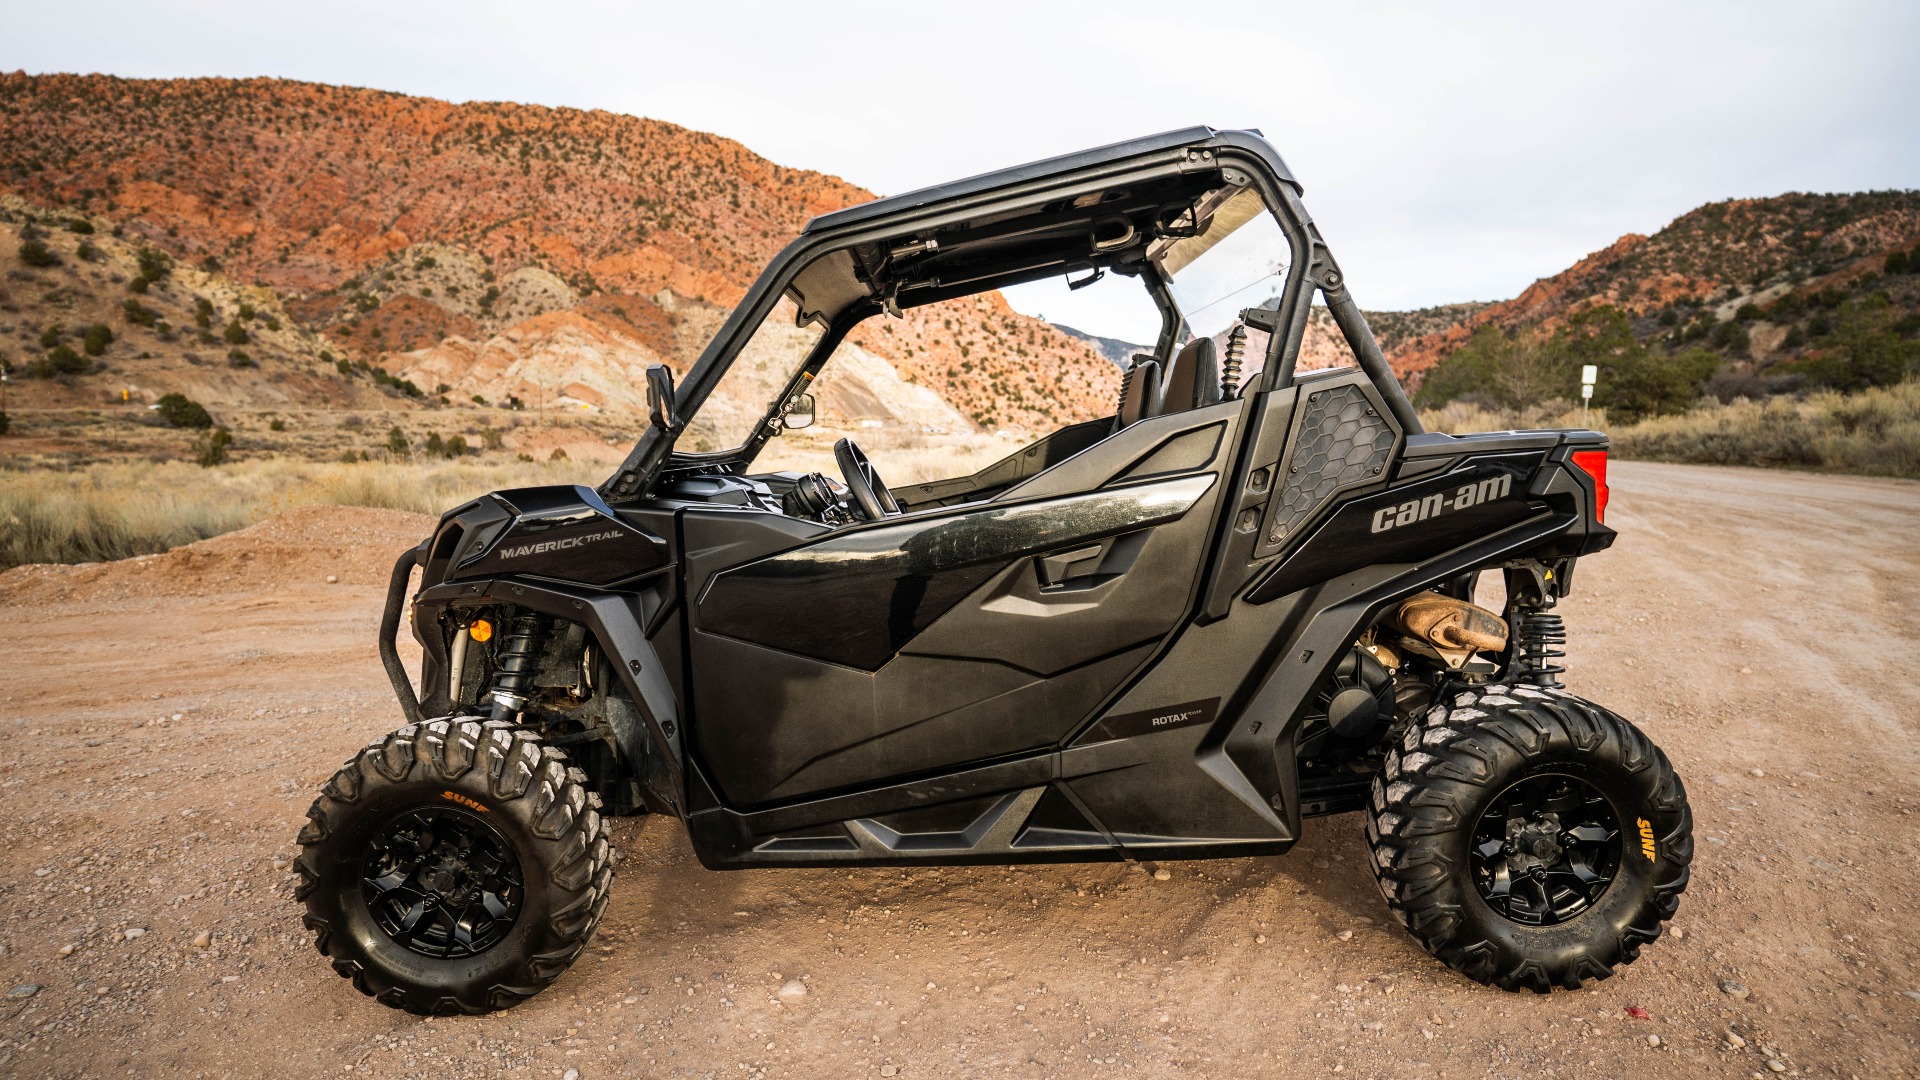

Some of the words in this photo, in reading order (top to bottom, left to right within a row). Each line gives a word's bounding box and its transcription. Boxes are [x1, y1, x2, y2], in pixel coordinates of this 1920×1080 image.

[1371, 473, 1512, 534] can-am
[500, 536, 584, 559] MAVERICK
[585, 530, 624, 543] TRAIL
[1152, 712, 1188, 726] ROTAX
[440, 791, 490, 812] SUNF
[1636, 816, 1656, 864] SUNF
